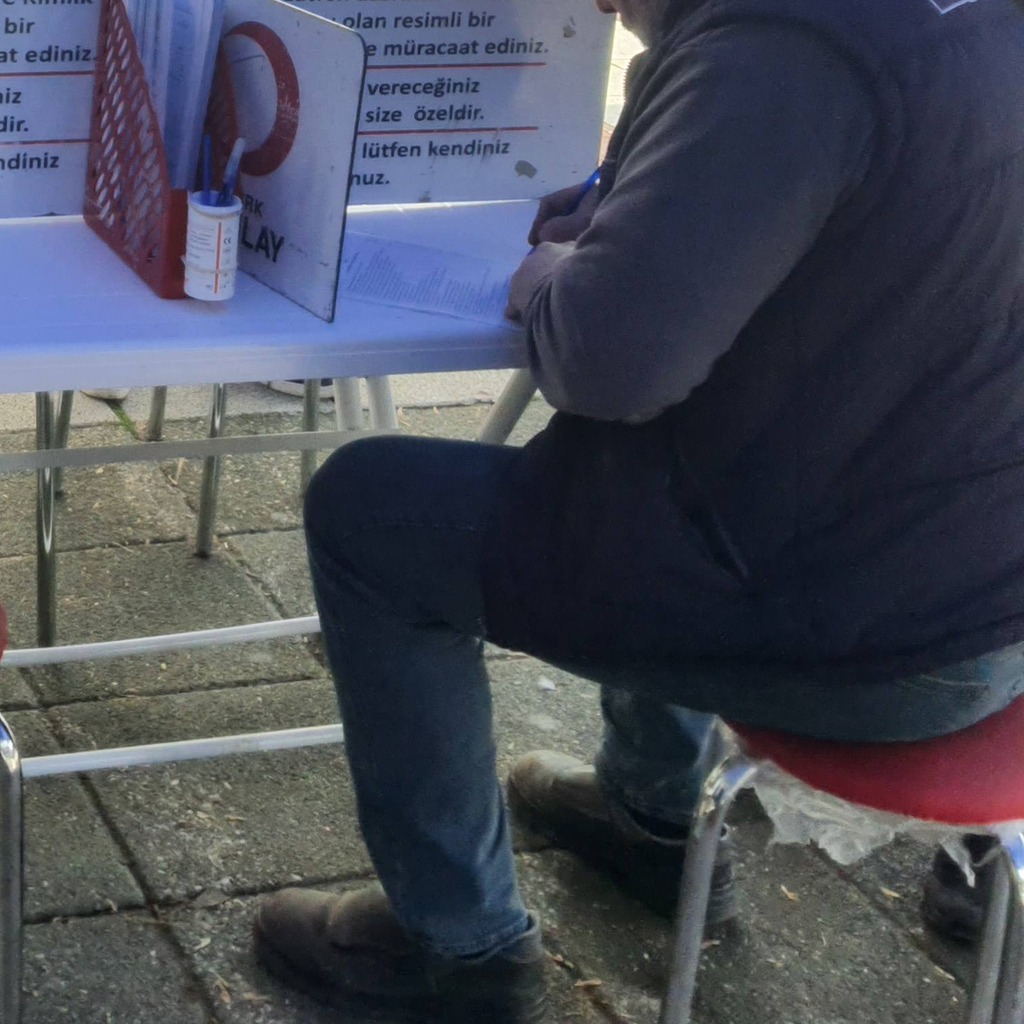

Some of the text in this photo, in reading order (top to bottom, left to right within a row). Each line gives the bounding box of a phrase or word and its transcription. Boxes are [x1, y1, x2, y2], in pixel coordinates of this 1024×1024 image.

[5, 17, 34, 34] bir
[342, 12, 495, 29] olan resimli bir
[25, 46, 97, 63] ediniz.
[384, 40, 478, 57] müracaat
[485, 38, 548, 55] ediniz.
[367, 78, 480, 98] vereceğiniz
[365, 105, 484, 123] size özeldir.
[362, 140, 511, 159] lütfen kendiniz
